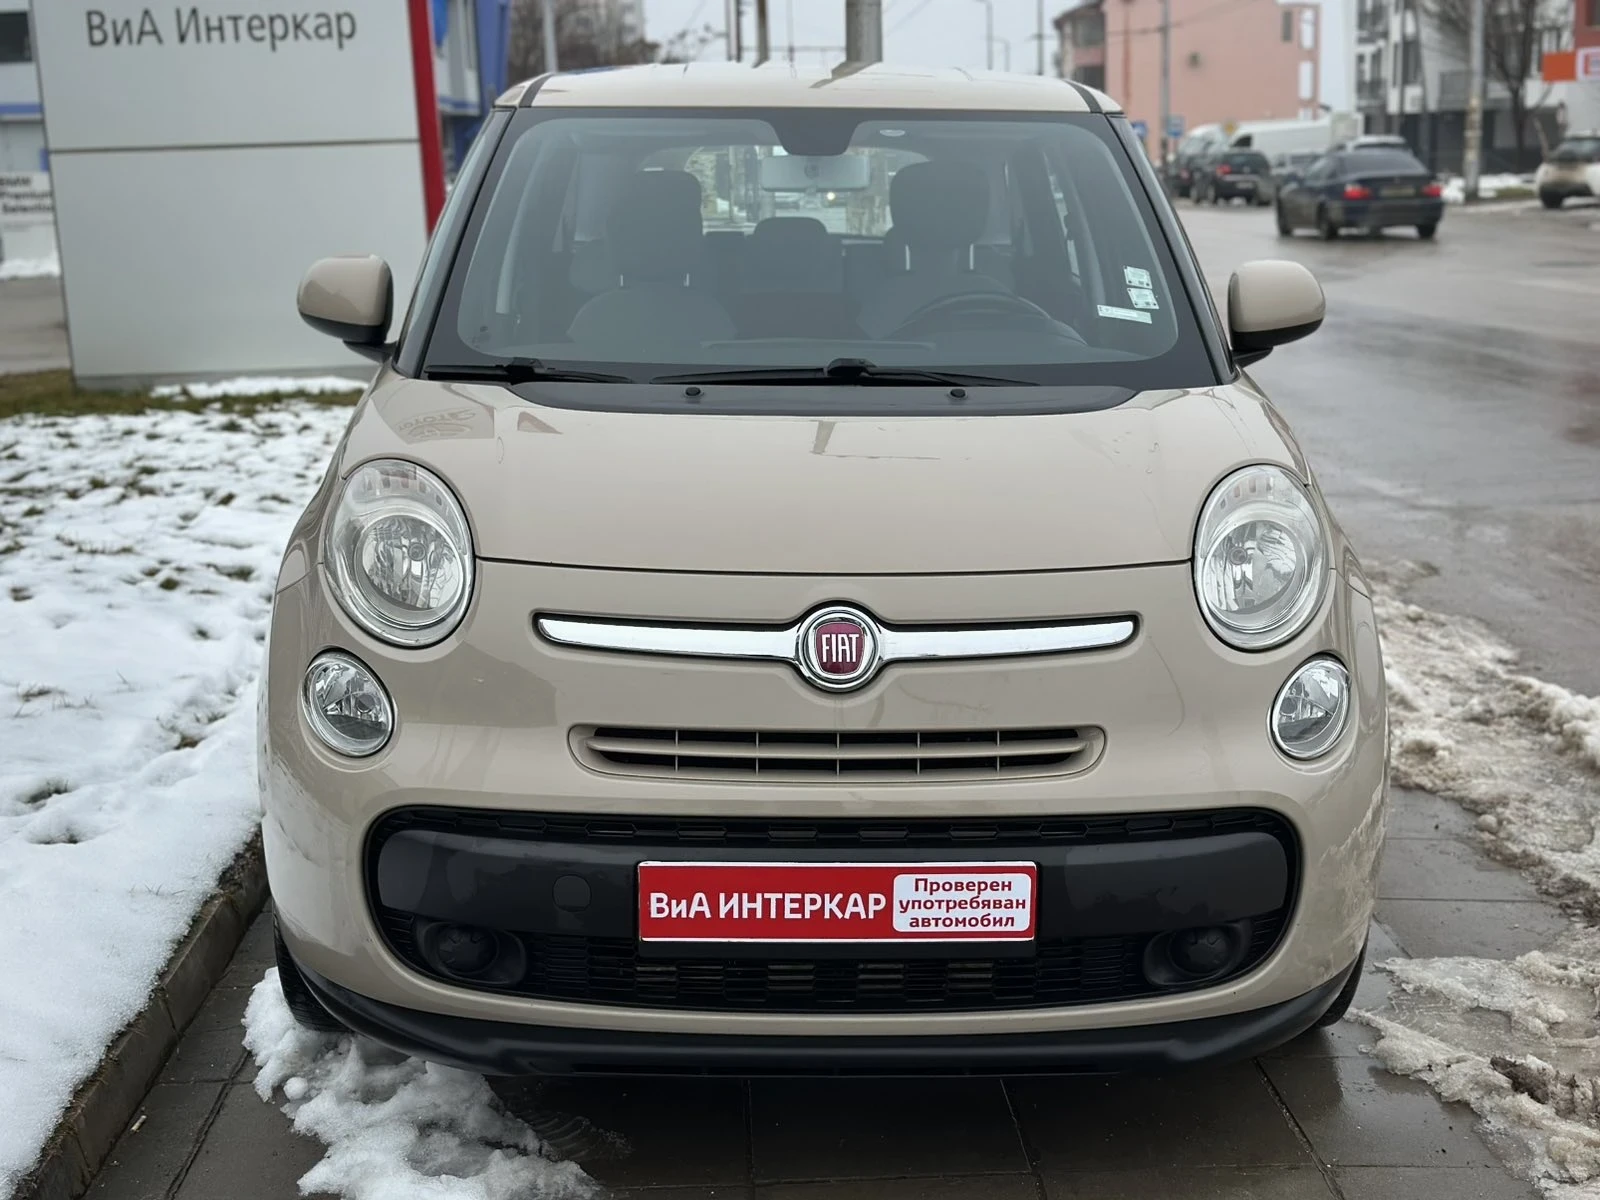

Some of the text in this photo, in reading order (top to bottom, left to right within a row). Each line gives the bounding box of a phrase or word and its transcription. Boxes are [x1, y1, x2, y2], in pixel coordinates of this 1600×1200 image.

[86, 8, 357, 51] ВиА Интеркар
[821, 633, 860, 663] FIAT
[914, 878, 1012, 895] Проверен
[650, 892, 887, 920] ВиА ИНТЕРКАР
[898, 896, 1026, 913] употребяван
[909, 912, 1014, 928] автомобил
